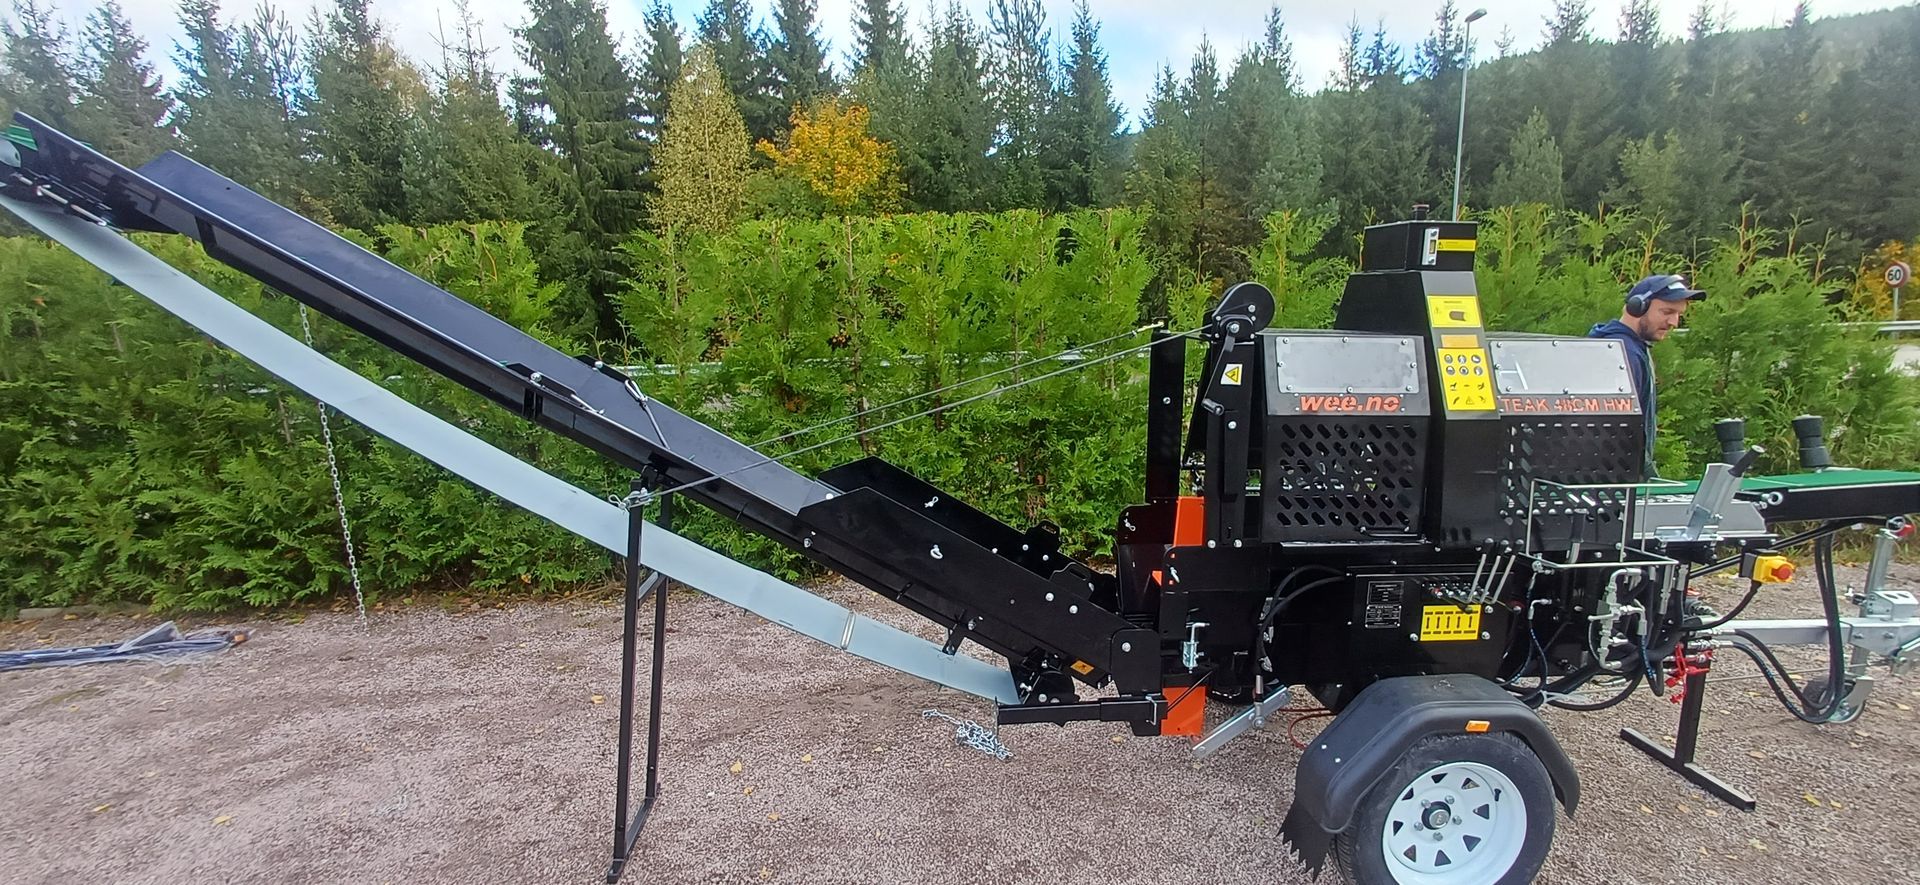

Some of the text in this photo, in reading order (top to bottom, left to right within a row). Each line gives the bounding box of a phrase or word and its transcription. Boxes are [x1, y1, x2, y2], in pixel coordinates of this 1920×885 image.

[1887, 269, 1901, 281] 60
[1300, 395, 1400, 412] wee.no
[1501, 397, 1549, 412] TEAK
[1603, 397, 1633, 412] HW
